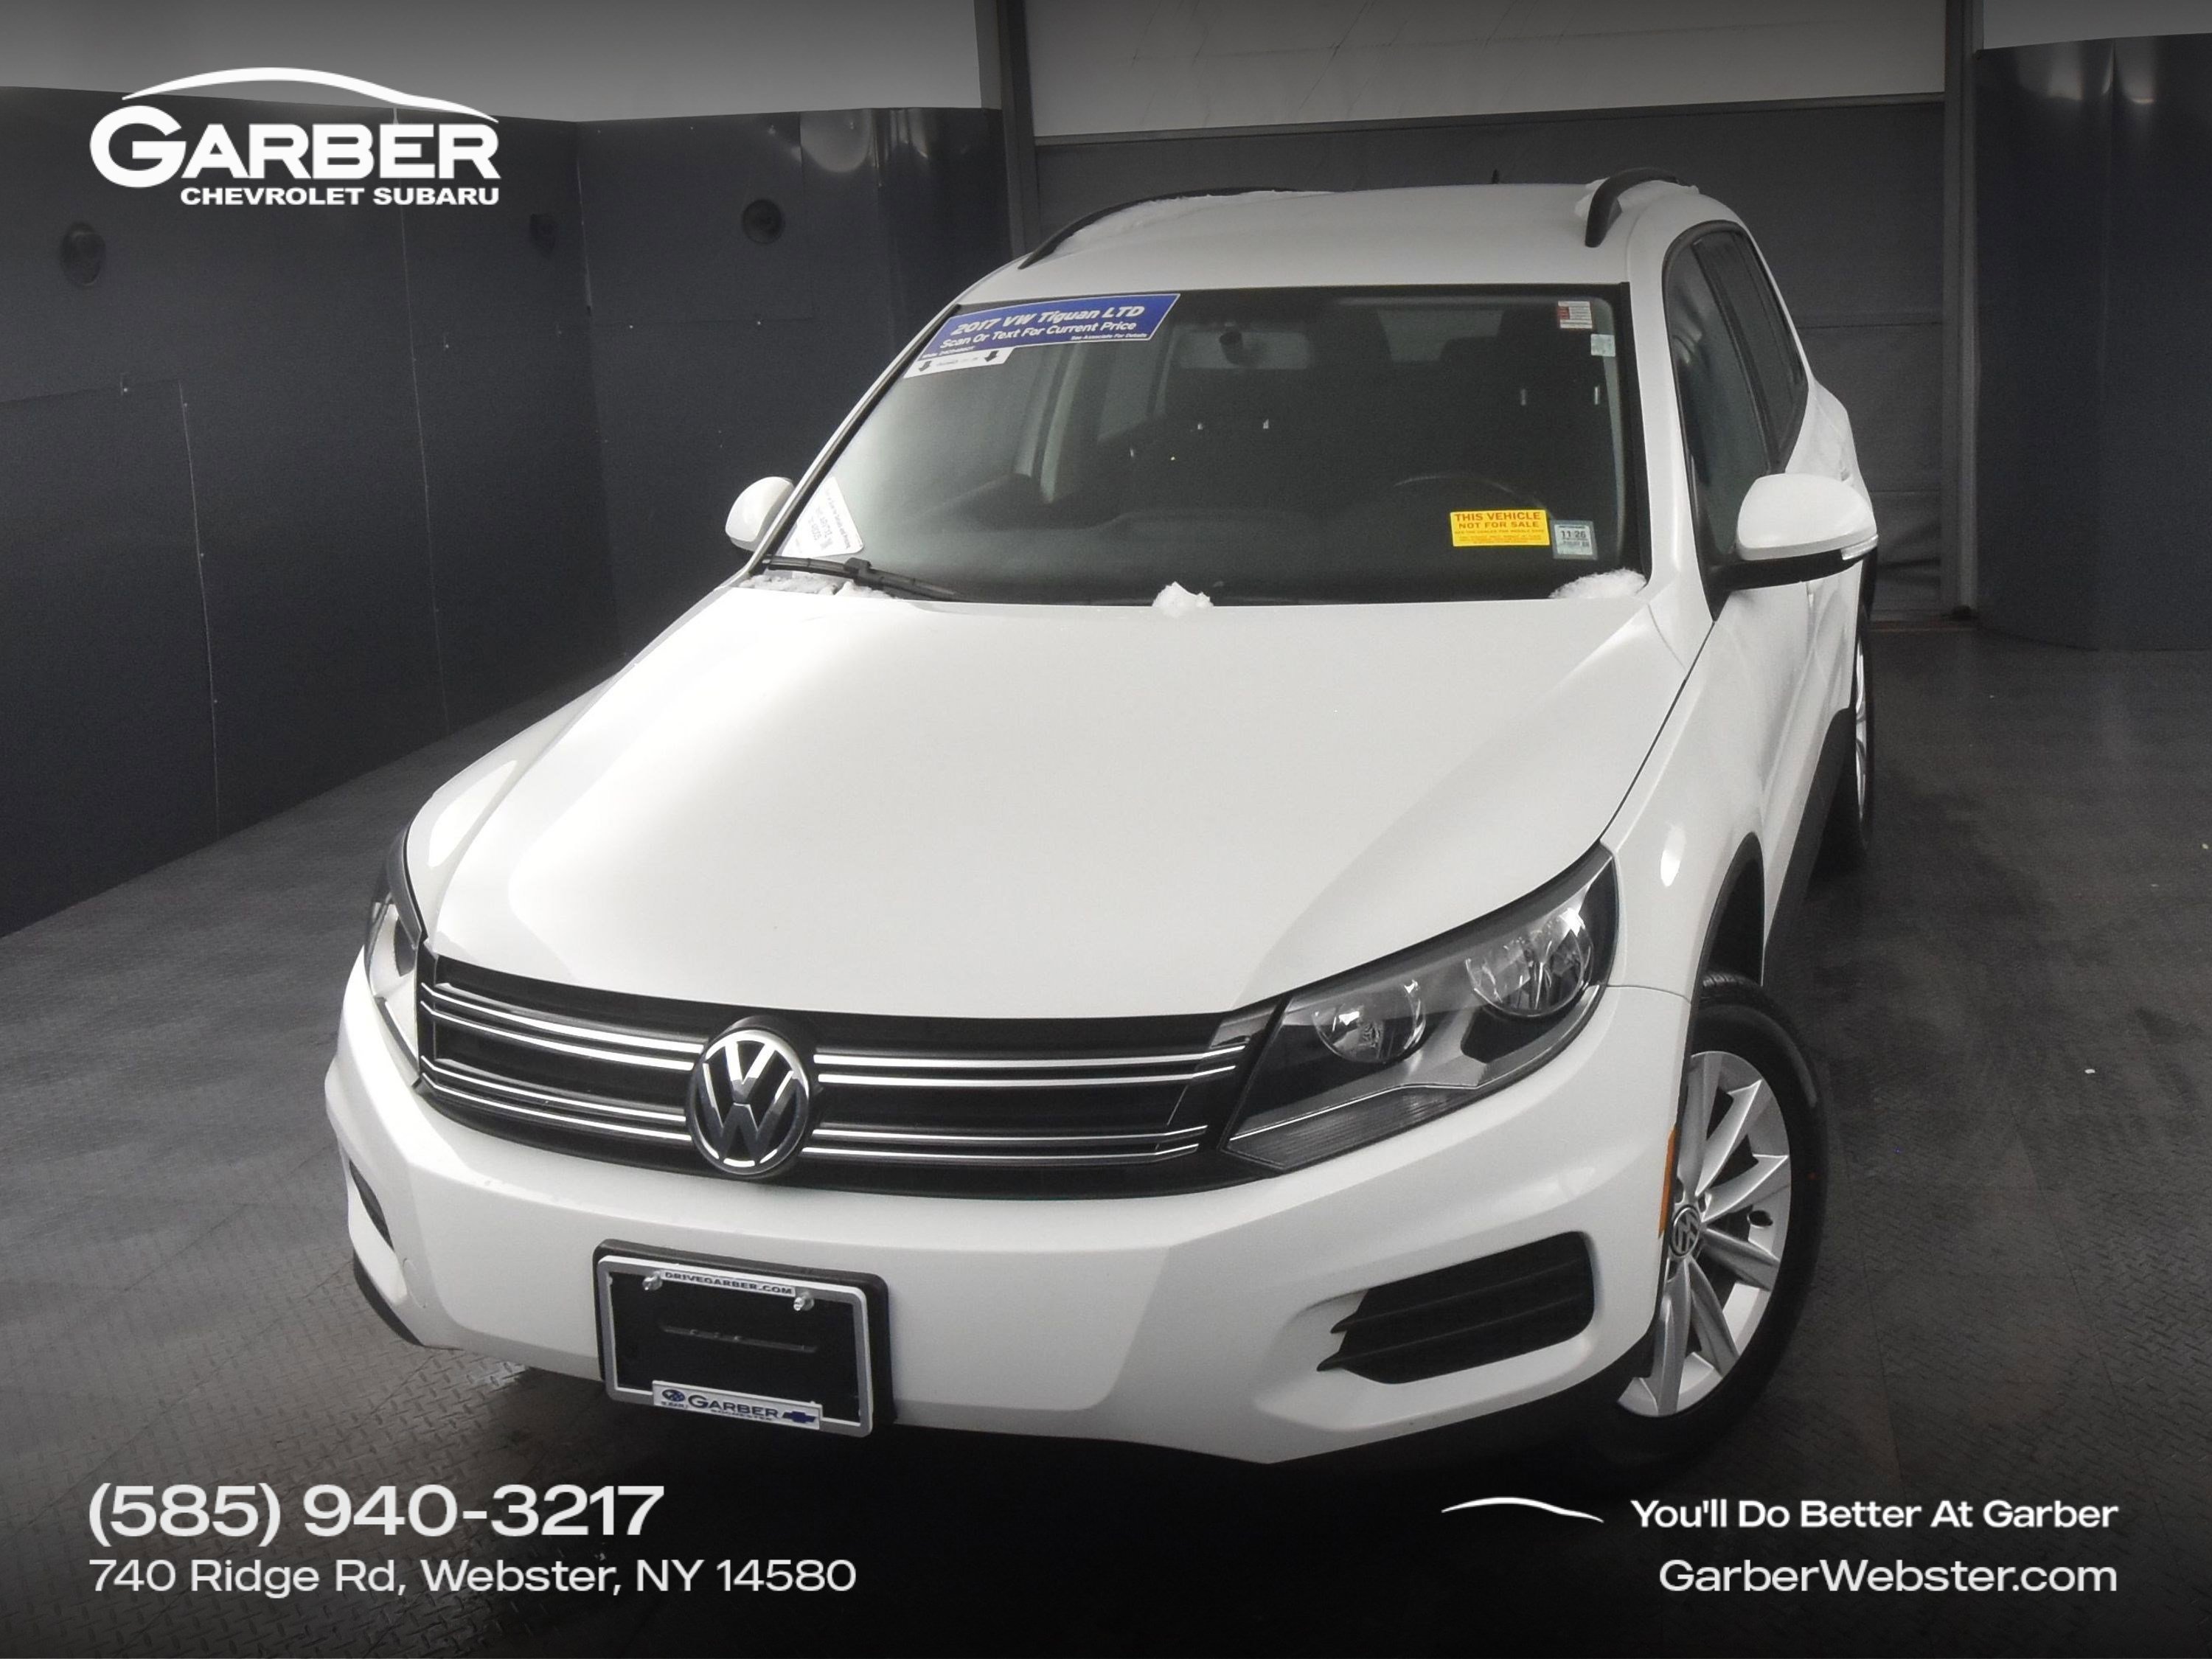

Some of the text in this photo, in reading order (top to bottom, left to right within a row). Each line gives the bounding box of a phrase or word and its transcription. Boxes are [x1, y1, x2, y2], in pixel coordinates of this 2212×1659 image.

[950, 305, 1145, 335] 2017 VW Tiguan LTD
[940, 321, 1137, 349] Scan Or Text For Current Price
[1455, 512, 1541, 521] THIS VEHICLE
[665, 1272, 793, 1294] DRIVEGARBER.COM
[688, 1394, 779, 1418] GARBER
